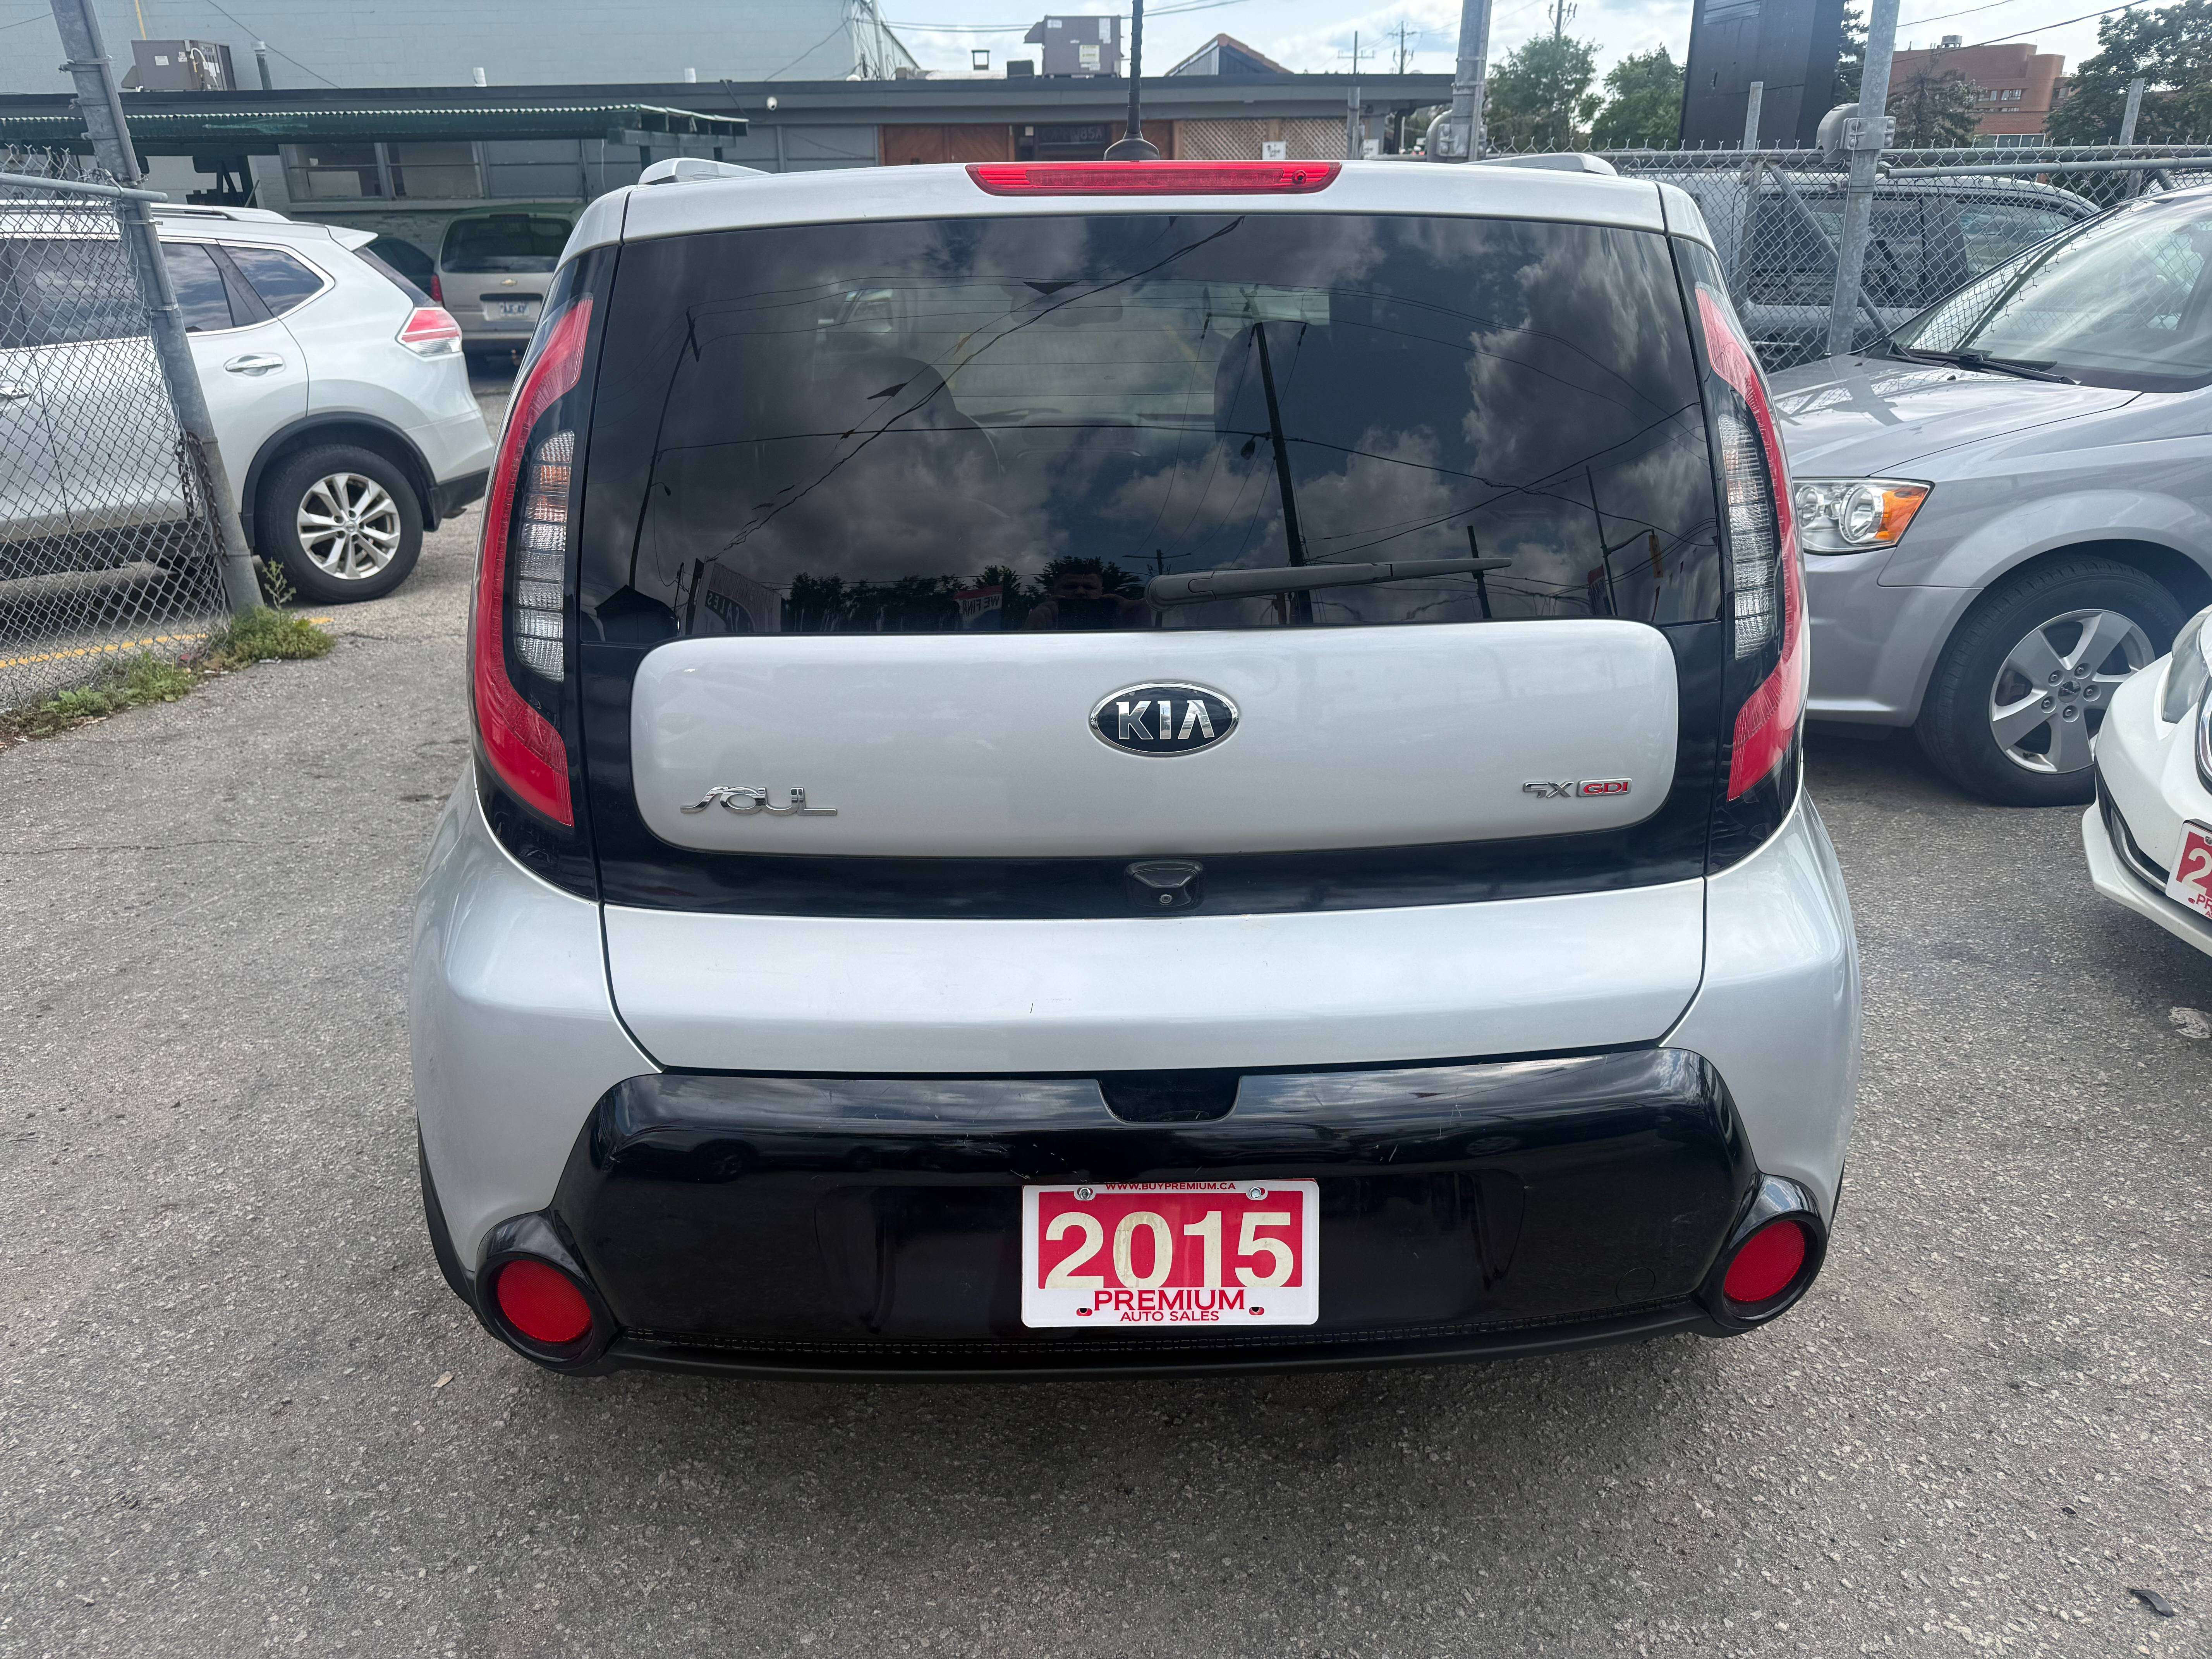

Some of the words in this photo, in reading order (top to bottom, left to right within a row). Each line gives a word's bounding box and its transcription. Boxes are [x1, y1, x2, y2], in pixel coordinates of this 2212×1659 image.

[1116, 700, 1215, 740] KIA
[1523, 781, 1574, 798] SX
[1583, 781, 1628, 795] GDI
[1044, 1211, 1294, 1289] 2015
[1094, 1289, 1245, 1311] PREMIUM
[1120, 1311, 1164, 1322] AUTO
[1170, 1310, 1219, 1321] SALES
